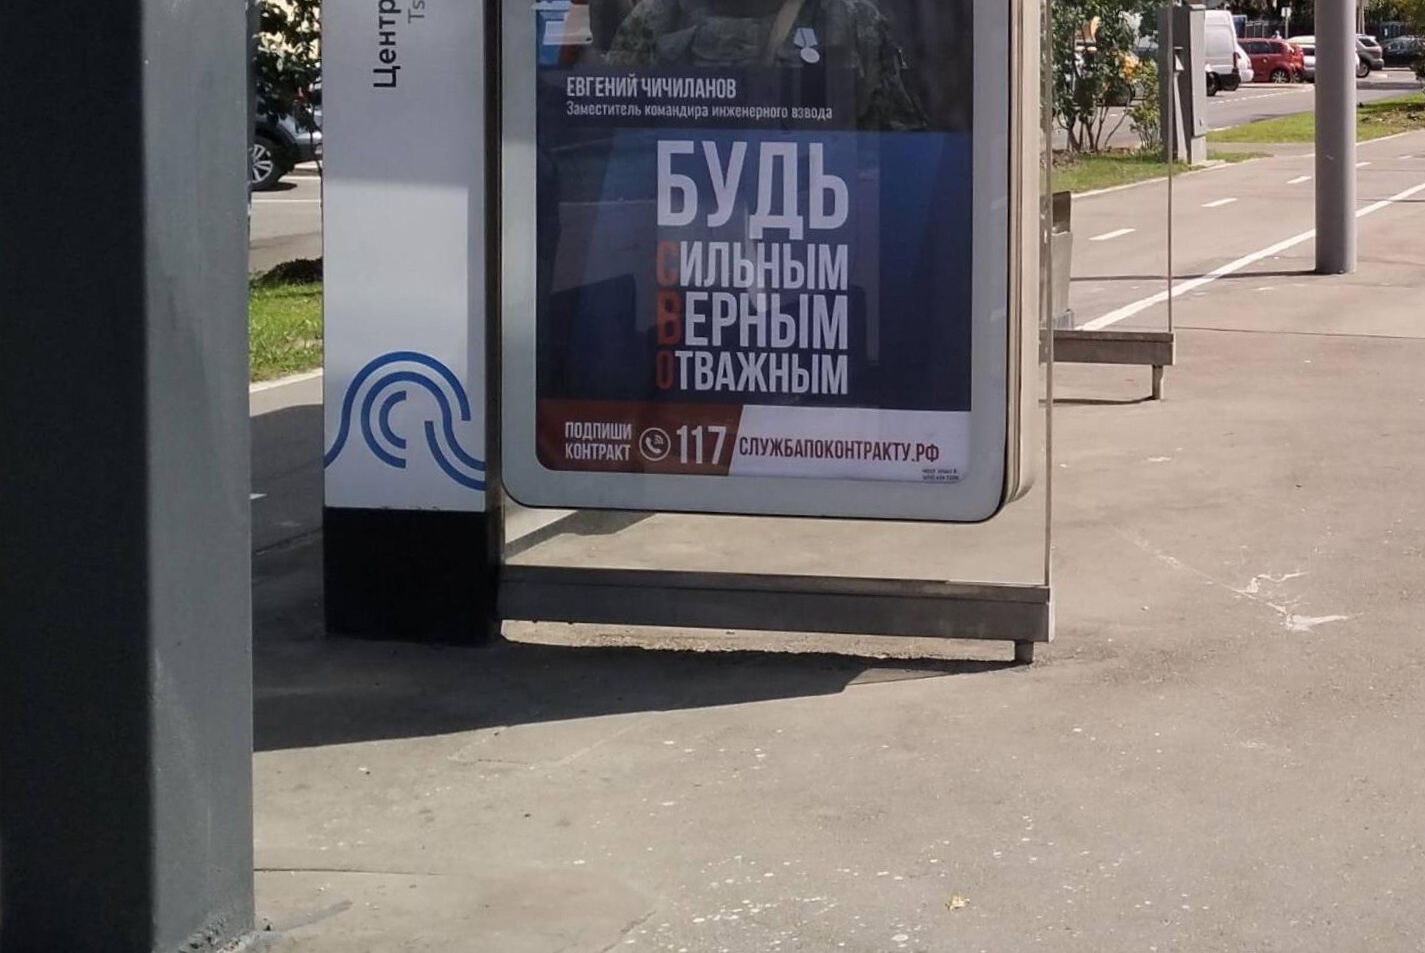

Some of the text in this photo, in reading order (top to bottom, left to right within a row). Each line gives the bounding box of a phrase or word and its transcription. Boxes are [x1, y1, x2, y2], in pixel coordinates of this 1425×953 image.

[566, 73, 737, 99] ЕВГЕНИЙ ЧИЧИЛАНОВ
[566, 101, 833, 120] Заместитель командира инженерного взвода
[657, 140, 849, 240] БУДЬ
[656, 240, 848, 291] СИЛЬНЫМ
[656, 290, 848, 350] ВЕРНЫМ
[656, 350, 848, 395] ОТВАЖНЫМ
[564, 421, 632, 441] ПОДПИШИ
[676, 425, 727, 465] 117
[564, 442, 632, 461] КОНТРАКТ
[739, 436, 940, 463] СЛУЖБАПОКОНТРАКТУ.РФ
